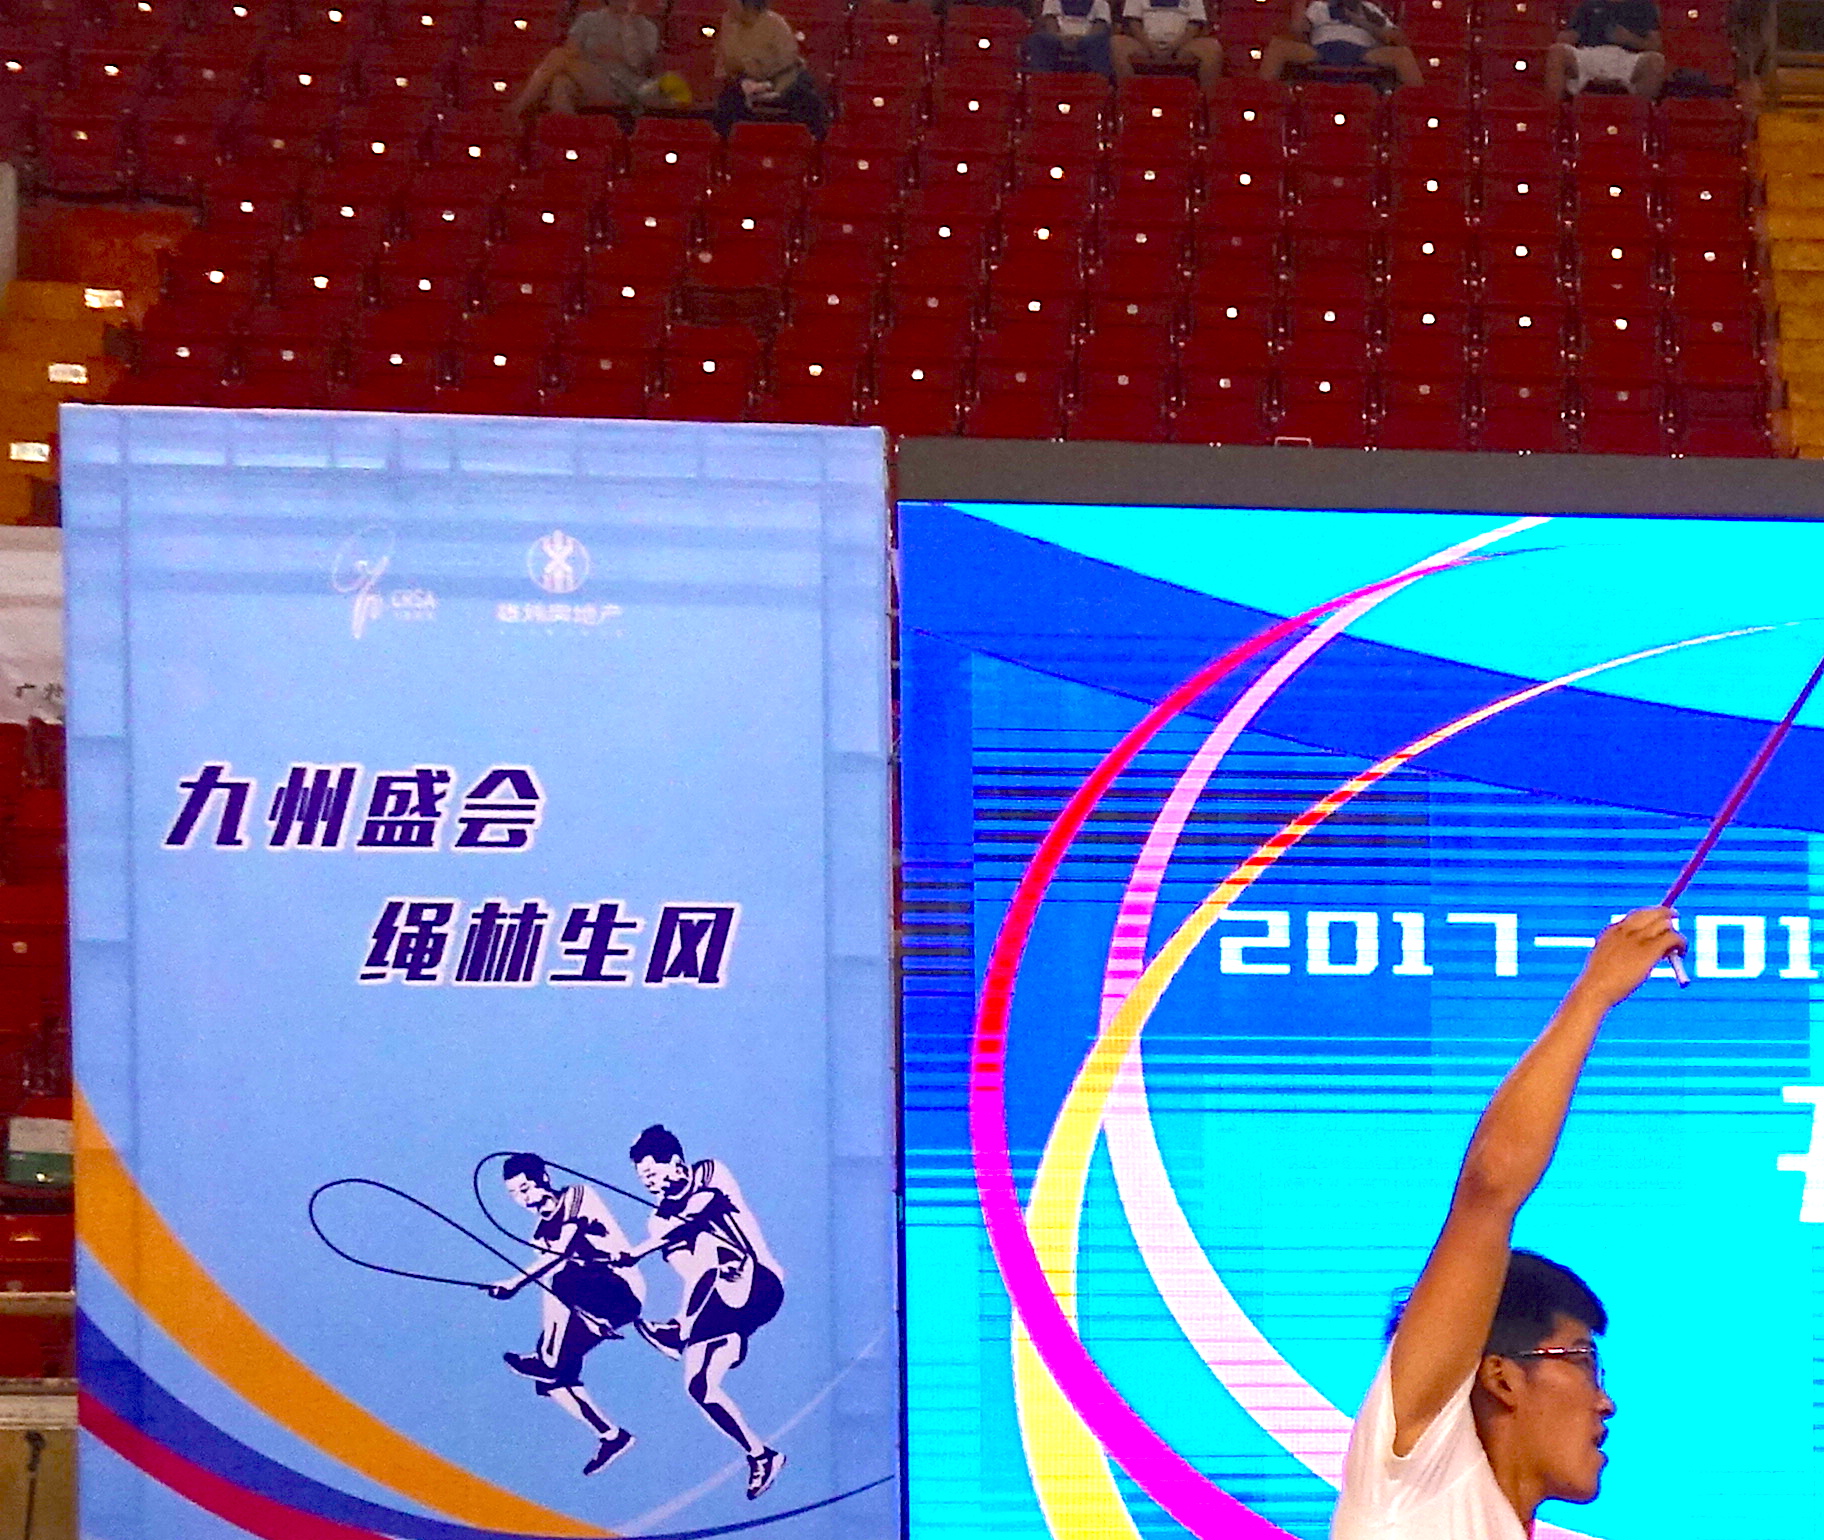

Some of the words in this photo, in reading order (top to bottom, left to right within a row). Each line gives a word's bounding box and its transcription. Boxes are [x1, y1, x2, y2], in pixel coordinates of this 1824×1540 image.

[165, 767, 542, 851] 九州盛会
[359, 901, 741, 986] 绳林生风
